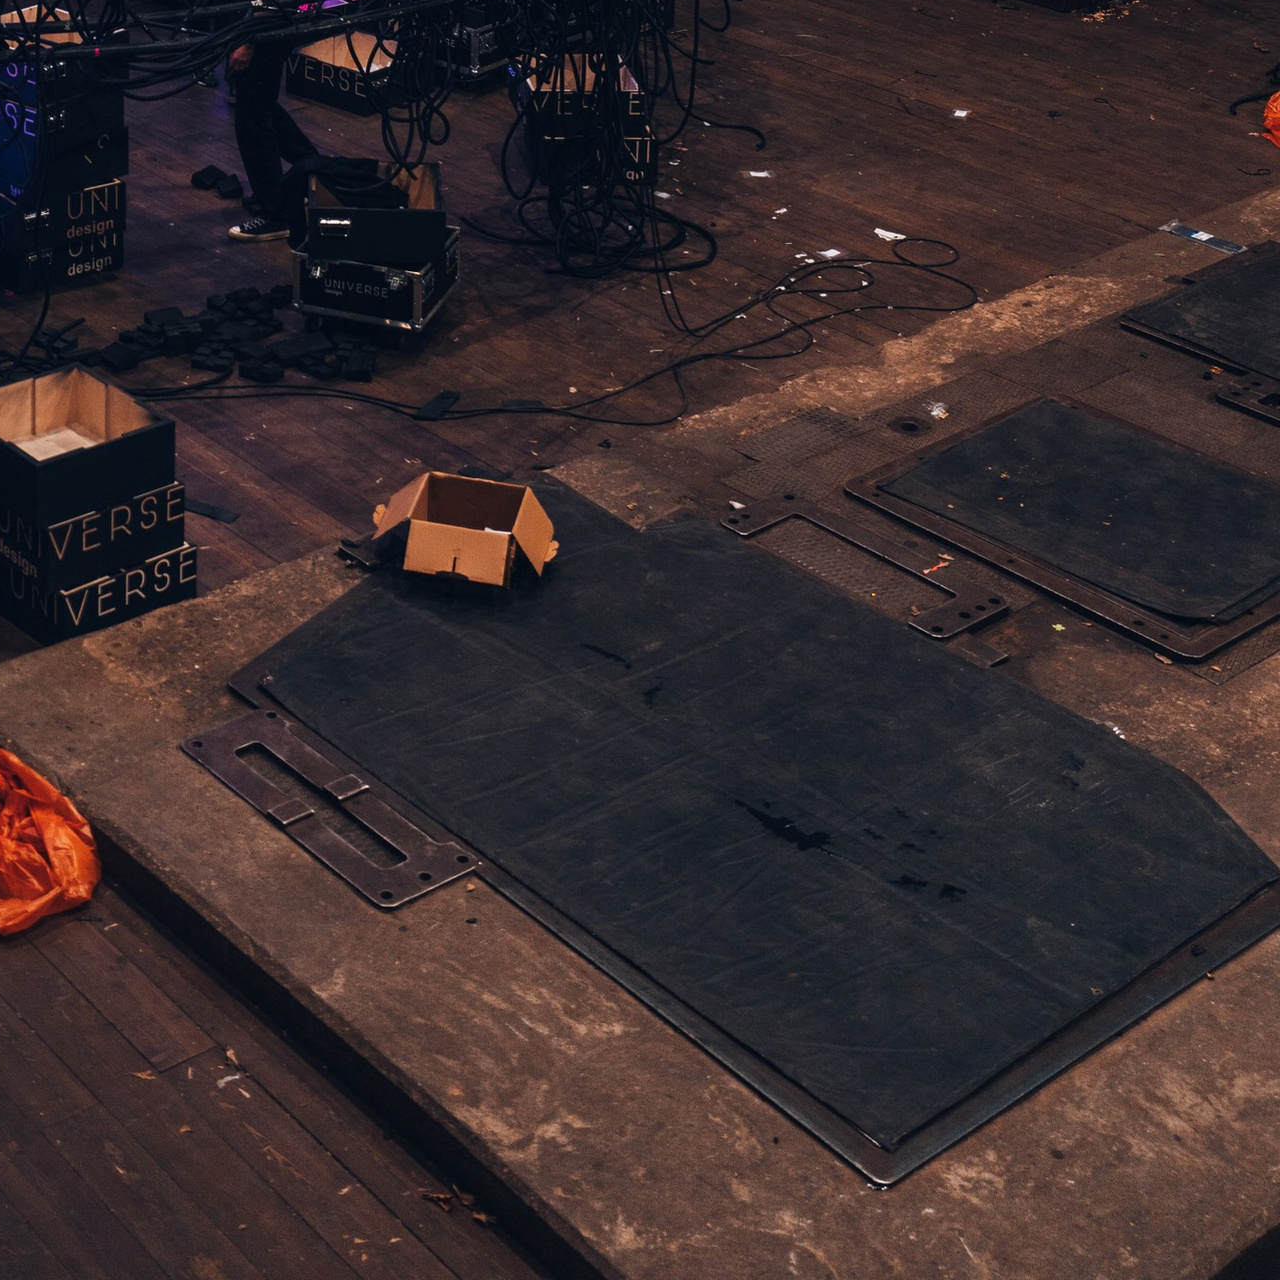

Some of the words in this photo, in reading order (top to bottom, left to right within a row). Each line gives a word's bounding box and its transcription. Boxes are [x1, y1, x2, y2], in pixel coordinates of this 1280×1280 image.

[287, 53, 367, 98] VERSE
[66, 184, 119, 220] UNI
[66, 219, 115, 239] design
[67, 255, 112, 277] design
[324, 278, 389, 299] UNIVERSE
[48, 484, 185, 560] VERSE
[65, 546, 197, 626] VERSE
